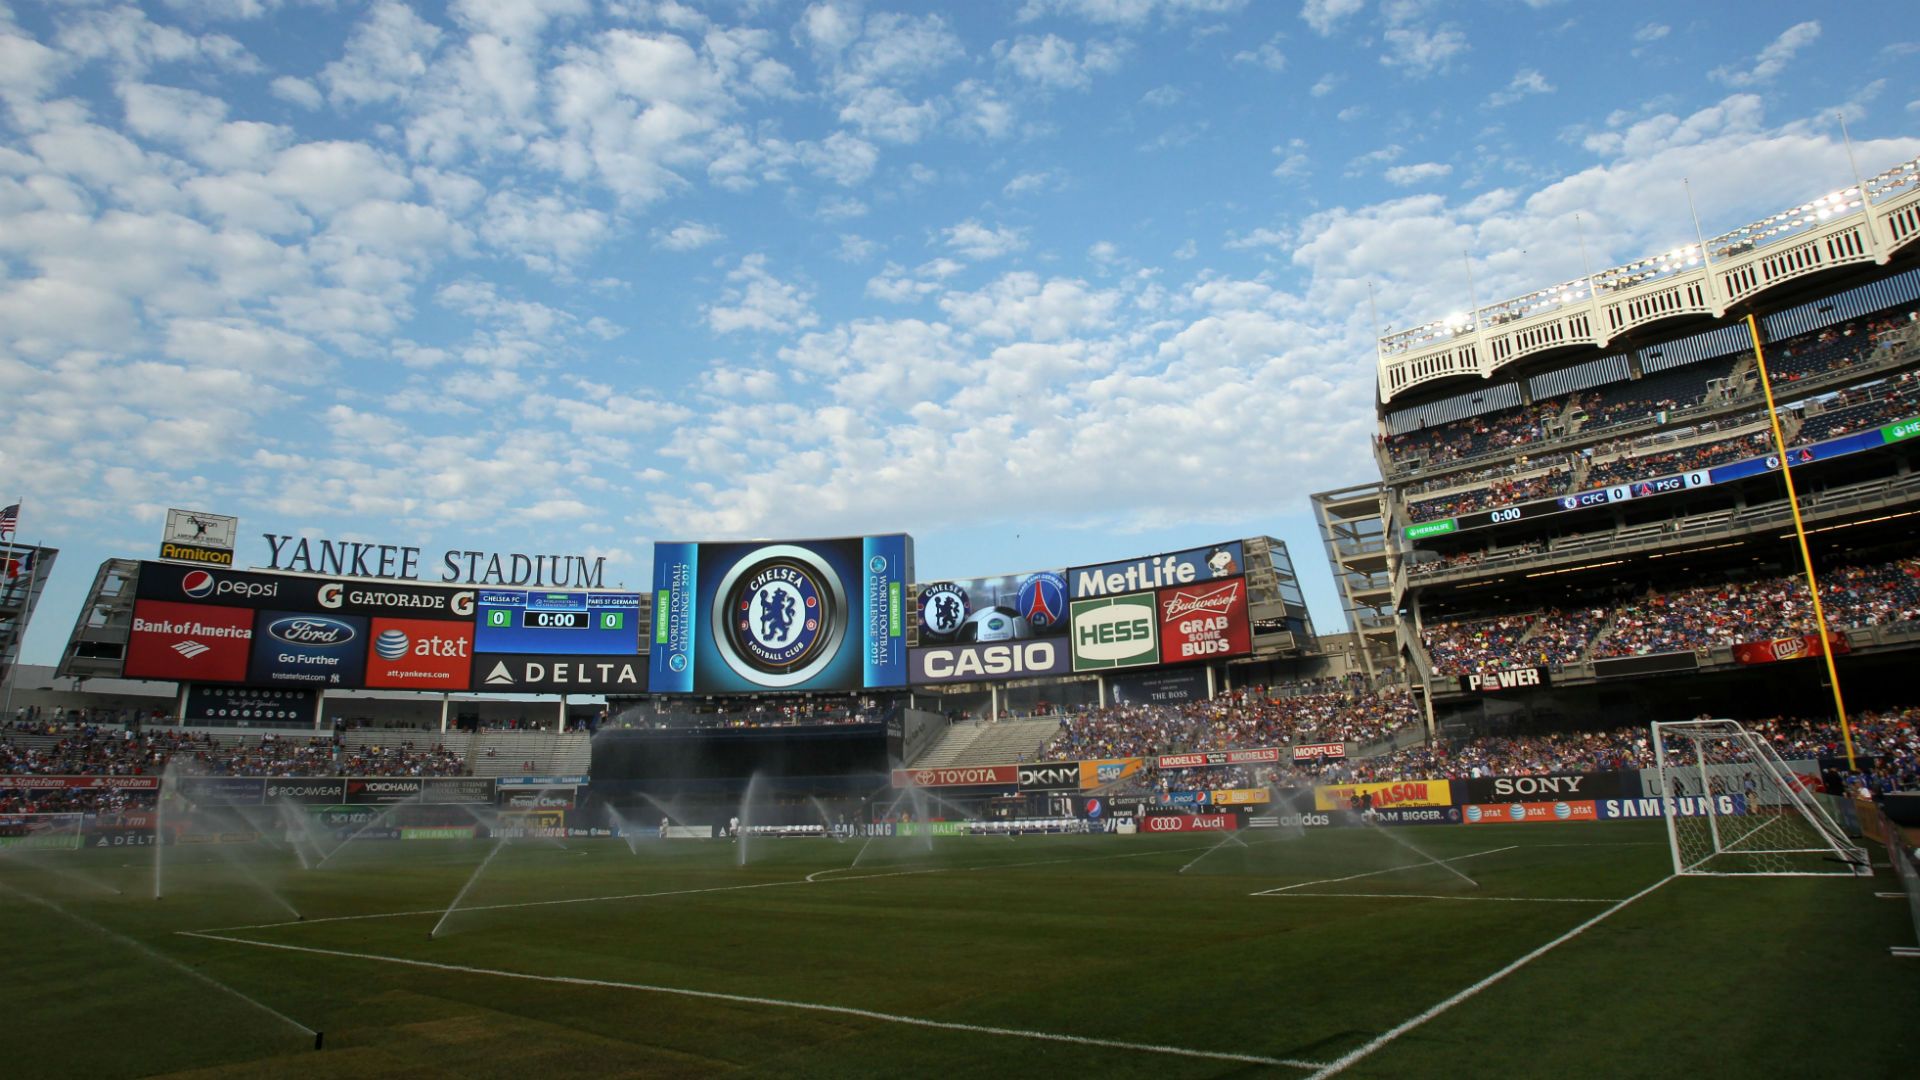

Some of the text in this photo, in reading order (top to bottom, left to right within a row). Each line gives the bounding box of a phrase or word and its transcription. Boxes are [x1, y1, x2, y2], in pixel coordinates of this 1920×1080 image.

[1656, 479, 1680, 492] PSG
[1691, 474, 1701, 486] 0
[1581, 493, 1605, 506] CFC
[1613, 488, 1623, 500] 0
[1491, 507, 1521, 523] 0:00
[1415, 522, 1449, 535] HERBALIFE
[163, 543, 231, 564] Armitron
[262, 533, 606, 589] YANKEE STADIUM
[750, 568, 804, 592] CHELSEA
[1078, 556, 1196, 598] MetLife
[216, 578, 279, 598] pepsi
[925, 583, 963, 598] CHELSEA
[349, 590, 446, 610] GATORADE
[482, 595, 510, 603] CHELSEA
[670, 562, 681, 651] WORLD FOOTBALL
[1163, 594, 1238, 615] Budweiser
[680, 564, 690, 651] CHALLENGE 2012
[493, 612, 505, 625] 0
[538, 613, 575, 626] 0:00
[606, 614, 617, 627] 0
[870, 576, 879, 665] CHALLENGE 2012
[879, 575, 888, 666] WORLD FOOTBALL
[1179, 616, 1229, 634] GRAB
[133, 617, 252, 640] Bank of America
[283, 617, 340, 643] Ford
[1080, 617, 1150, 646] HESS
[1188, 631, 1221, 642] SOME
[414, 635, 468, 659] at&t
[748, 640, 804, 660] FOOTBALL CLUB
[1181, 638, 1230, 657] BUDS
[278, 653, 340, 667] Go Further
[924, 642, 1055, 678] CASIO
[272, 672, 326, 681] tristateford.com
[386, 669, 450, 680] att.yankees.com
[525, 663, 638, 684] DELTA
[1469, 668, 1540, 691] PWER
[1152, 690, 1189, 700] THE BOSS
[1163, 750, 1275, 766] MODELL'S MODELL'S
[1294, 747, 1343, 758] MODELL'S
[937, 768, 997, 783] TOYOTA
[1019, 768, 1079, 785] DKNY
[1098, 767, 1121, 781] SAP
[279, 786, 342, 797] ROCAWEAR
[365, 782, 419, 792] YOKOHAMA
[1495, 776, 1584, 795] SONY
[1174, 794, 1193, 803] pepsi
[1484, 805, 1593, 818] at&t at&t at&t
[1606, 796, 1733, 818] SAMSUNG
[1192, 817, 1225, 829] Audi
[1280, 813, 1329, 826] adidas
[1402, 811, 1444, 821] BIGGER.
